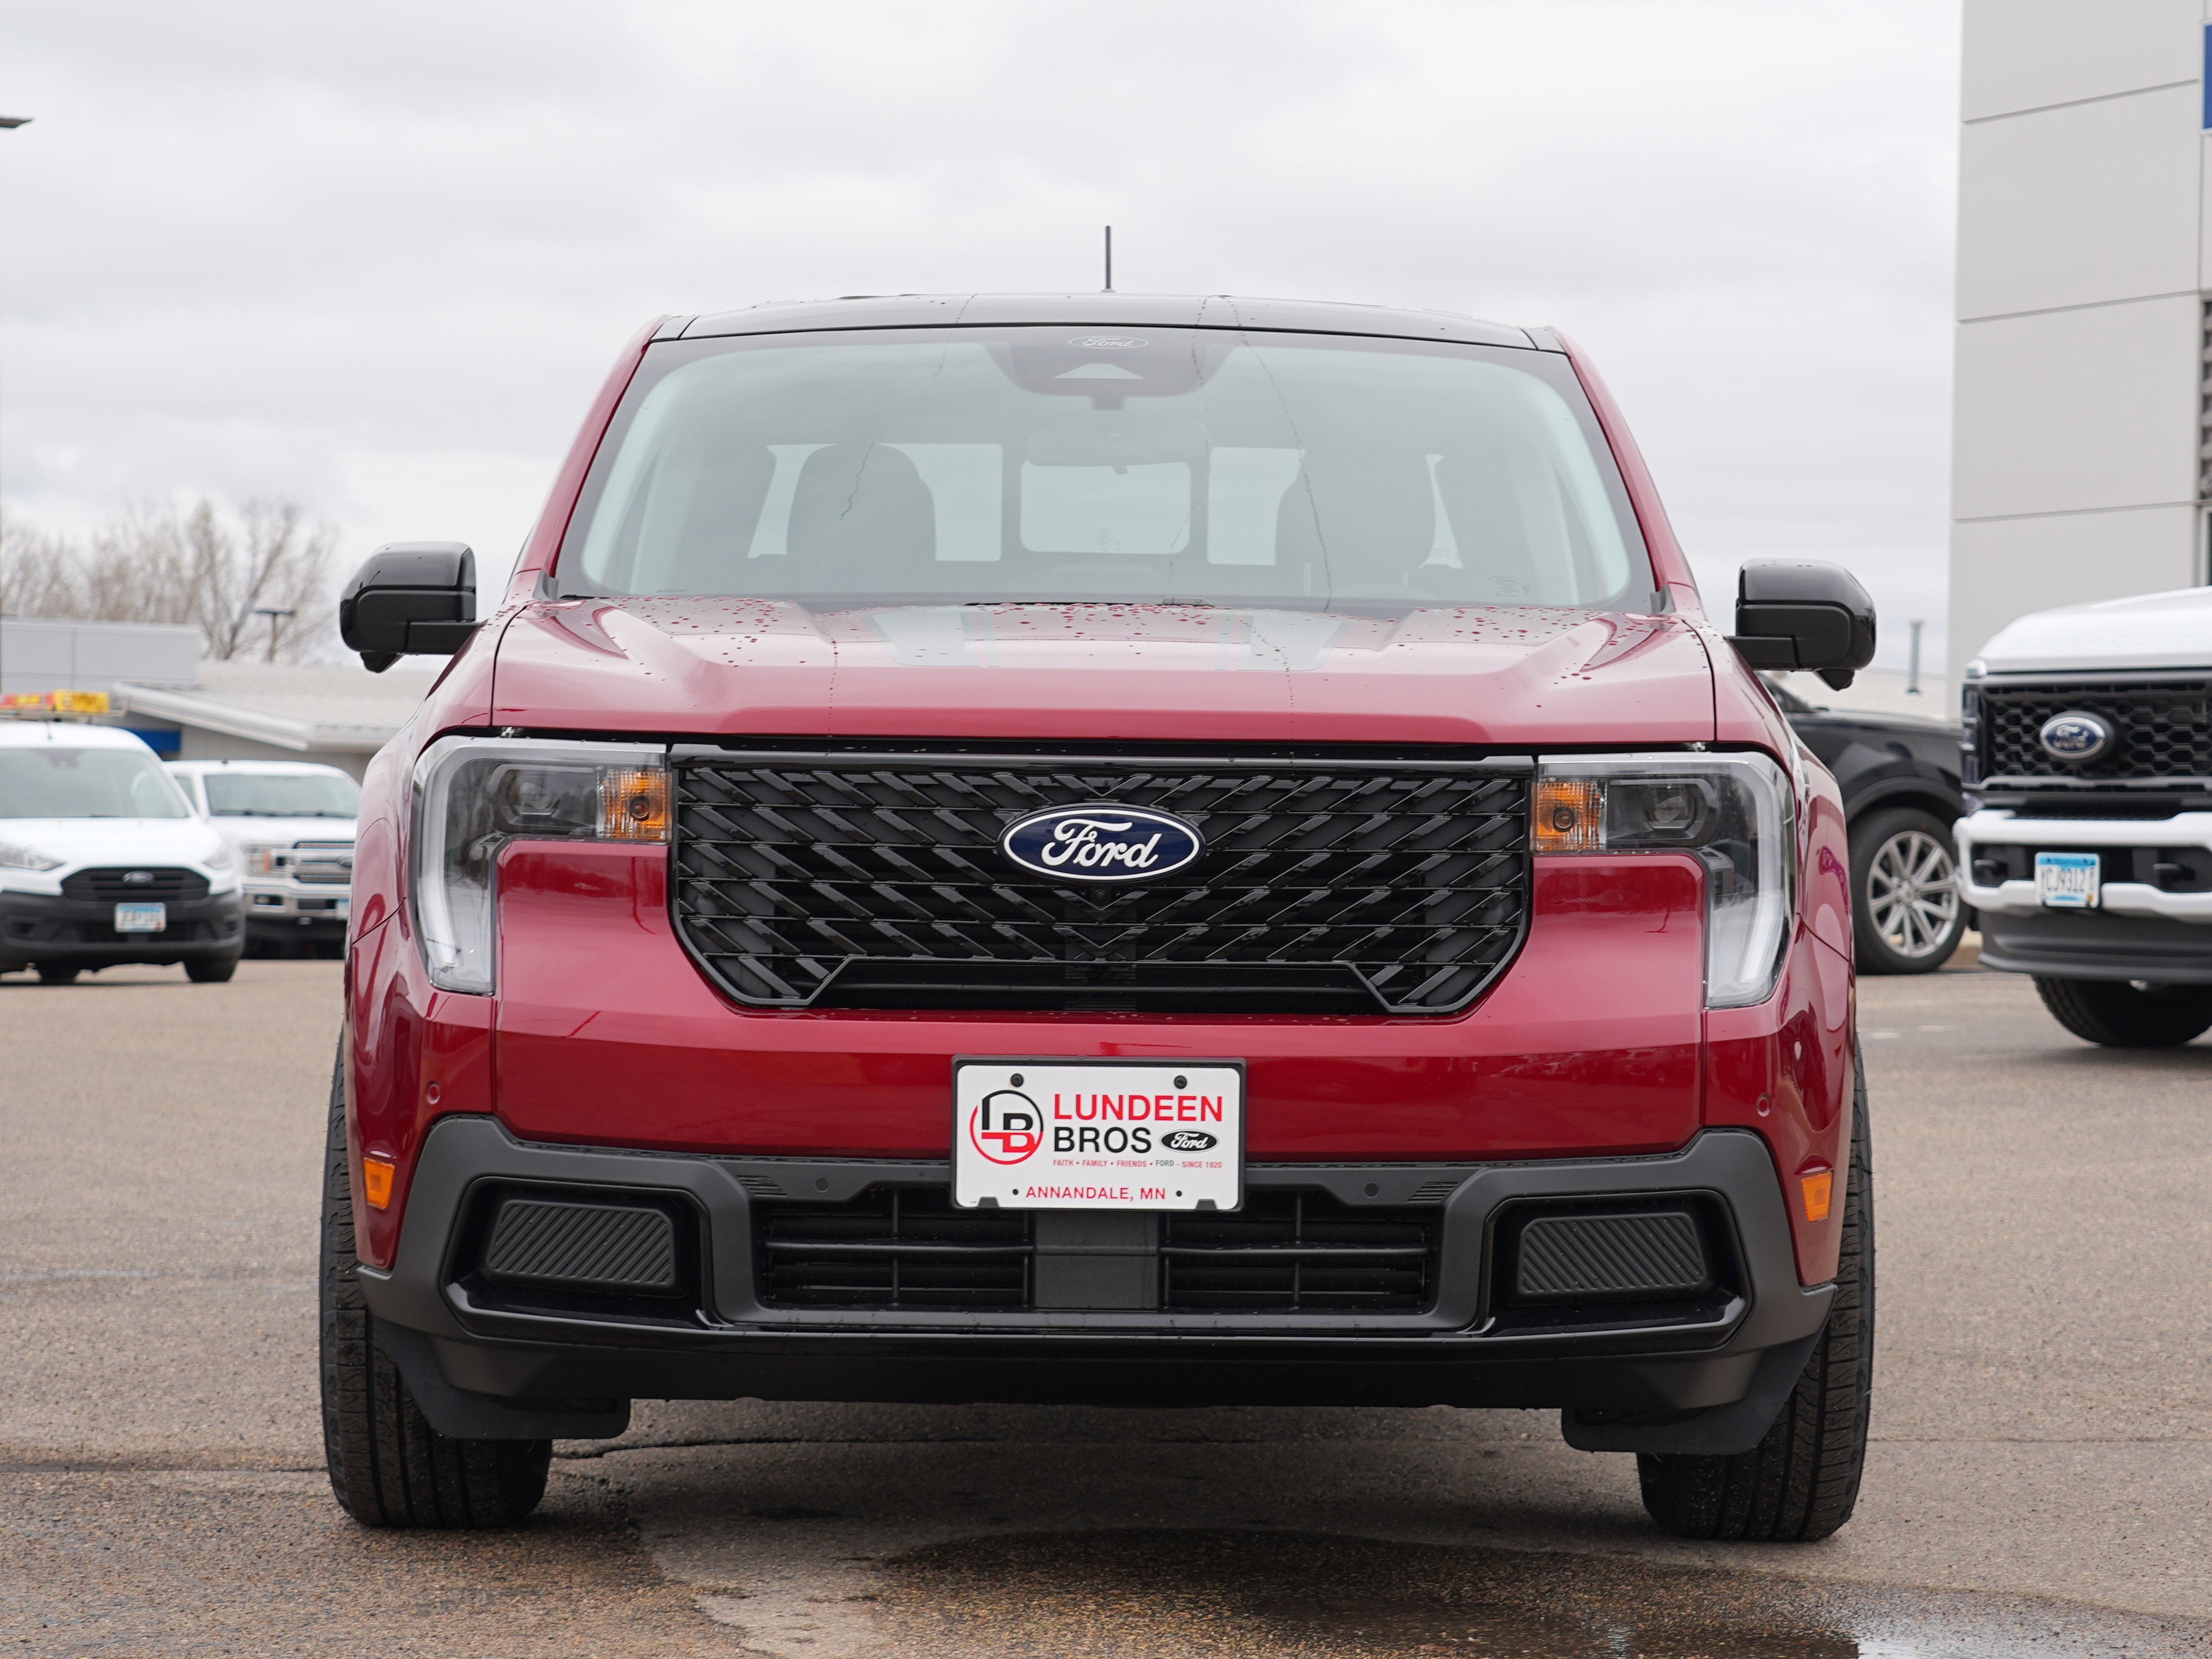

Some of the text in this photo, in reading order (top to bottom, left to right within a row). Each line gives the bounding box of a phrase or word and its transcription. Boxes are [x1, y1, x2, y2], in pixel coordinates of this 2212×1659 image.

[1082, 337, 1134, 347] Ford
[1041, 818, 1162, 868] Ford
[1054, 1094, 1223, 1122] LUNDEEN
[1054, 1127, 1152, 1154] BROS
[1170, 1131, 1209, 1149] Ford
[1026, 1186, 1166, 1202] ANNANDALE, MN
